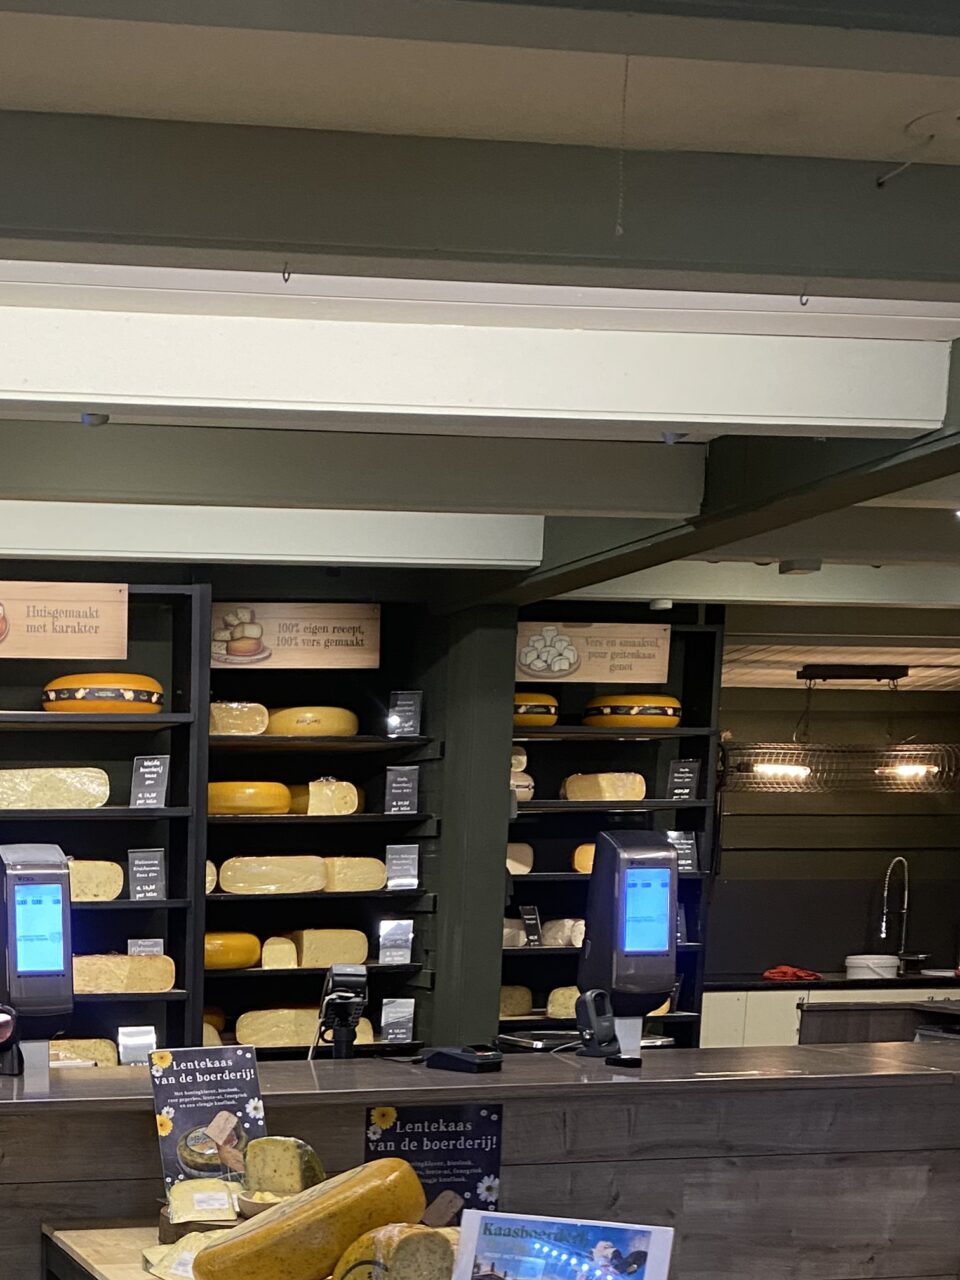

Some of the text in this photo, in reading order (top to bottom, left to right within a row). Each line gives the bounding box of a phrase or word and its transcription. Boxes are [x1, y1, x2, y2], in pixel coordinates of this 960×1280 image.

[26, 605, 100, 621] Huisgemaakt
[26, 621, 100, 635] met karakter
[276, 622, 365, 636] 100% eigen recept,
[276, 637, 365, 649] 100% vers gemaakt
[609, 662, 633, 673] genot
[172, 1057, 233, 1071] Lentekaas
[154, 1068, 255, 1086] van de boerderij!
[396, 1119, 473, 1133] Lentekaas
[369, 1136, 497, 1151] van de boerderij!
